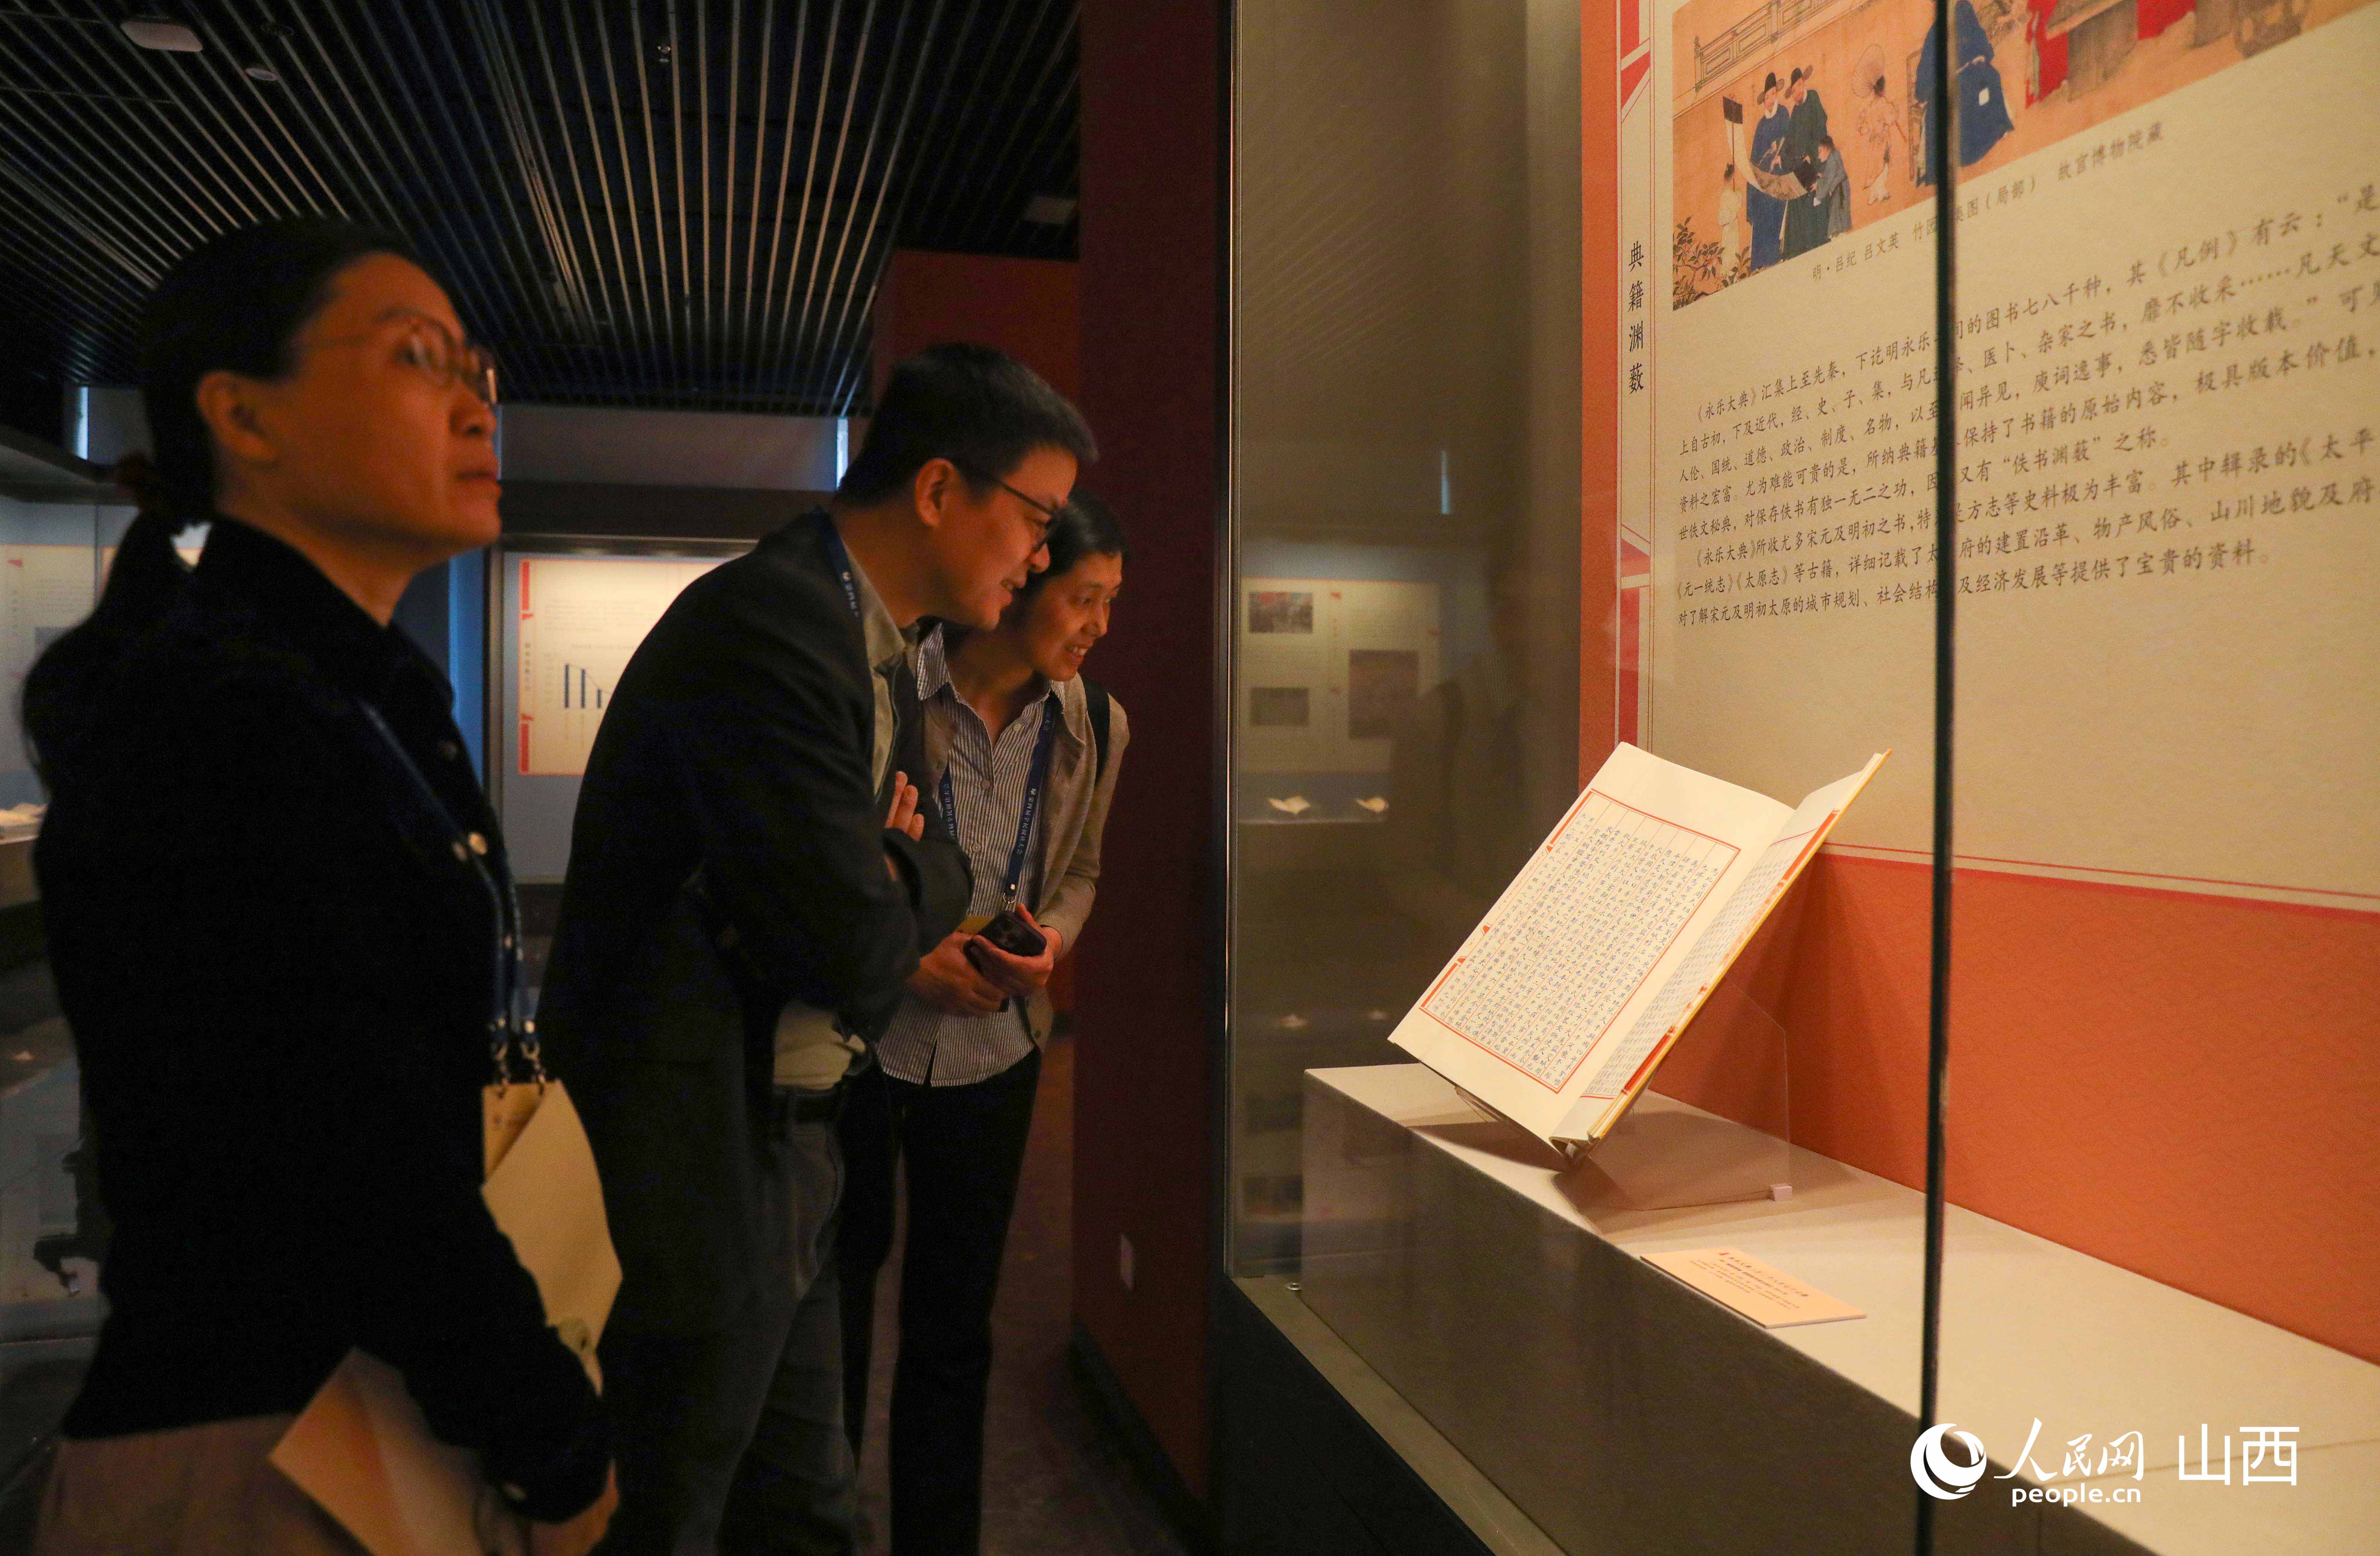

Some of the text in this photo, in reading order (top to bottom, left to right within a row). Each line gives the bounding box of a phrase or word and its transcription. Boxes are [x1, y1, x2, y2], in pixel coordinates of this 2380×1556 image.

[1912, 175, 2036, 242] 竹园图（局部）
[1628, 241, 1644, 394] 典籍渊薮
